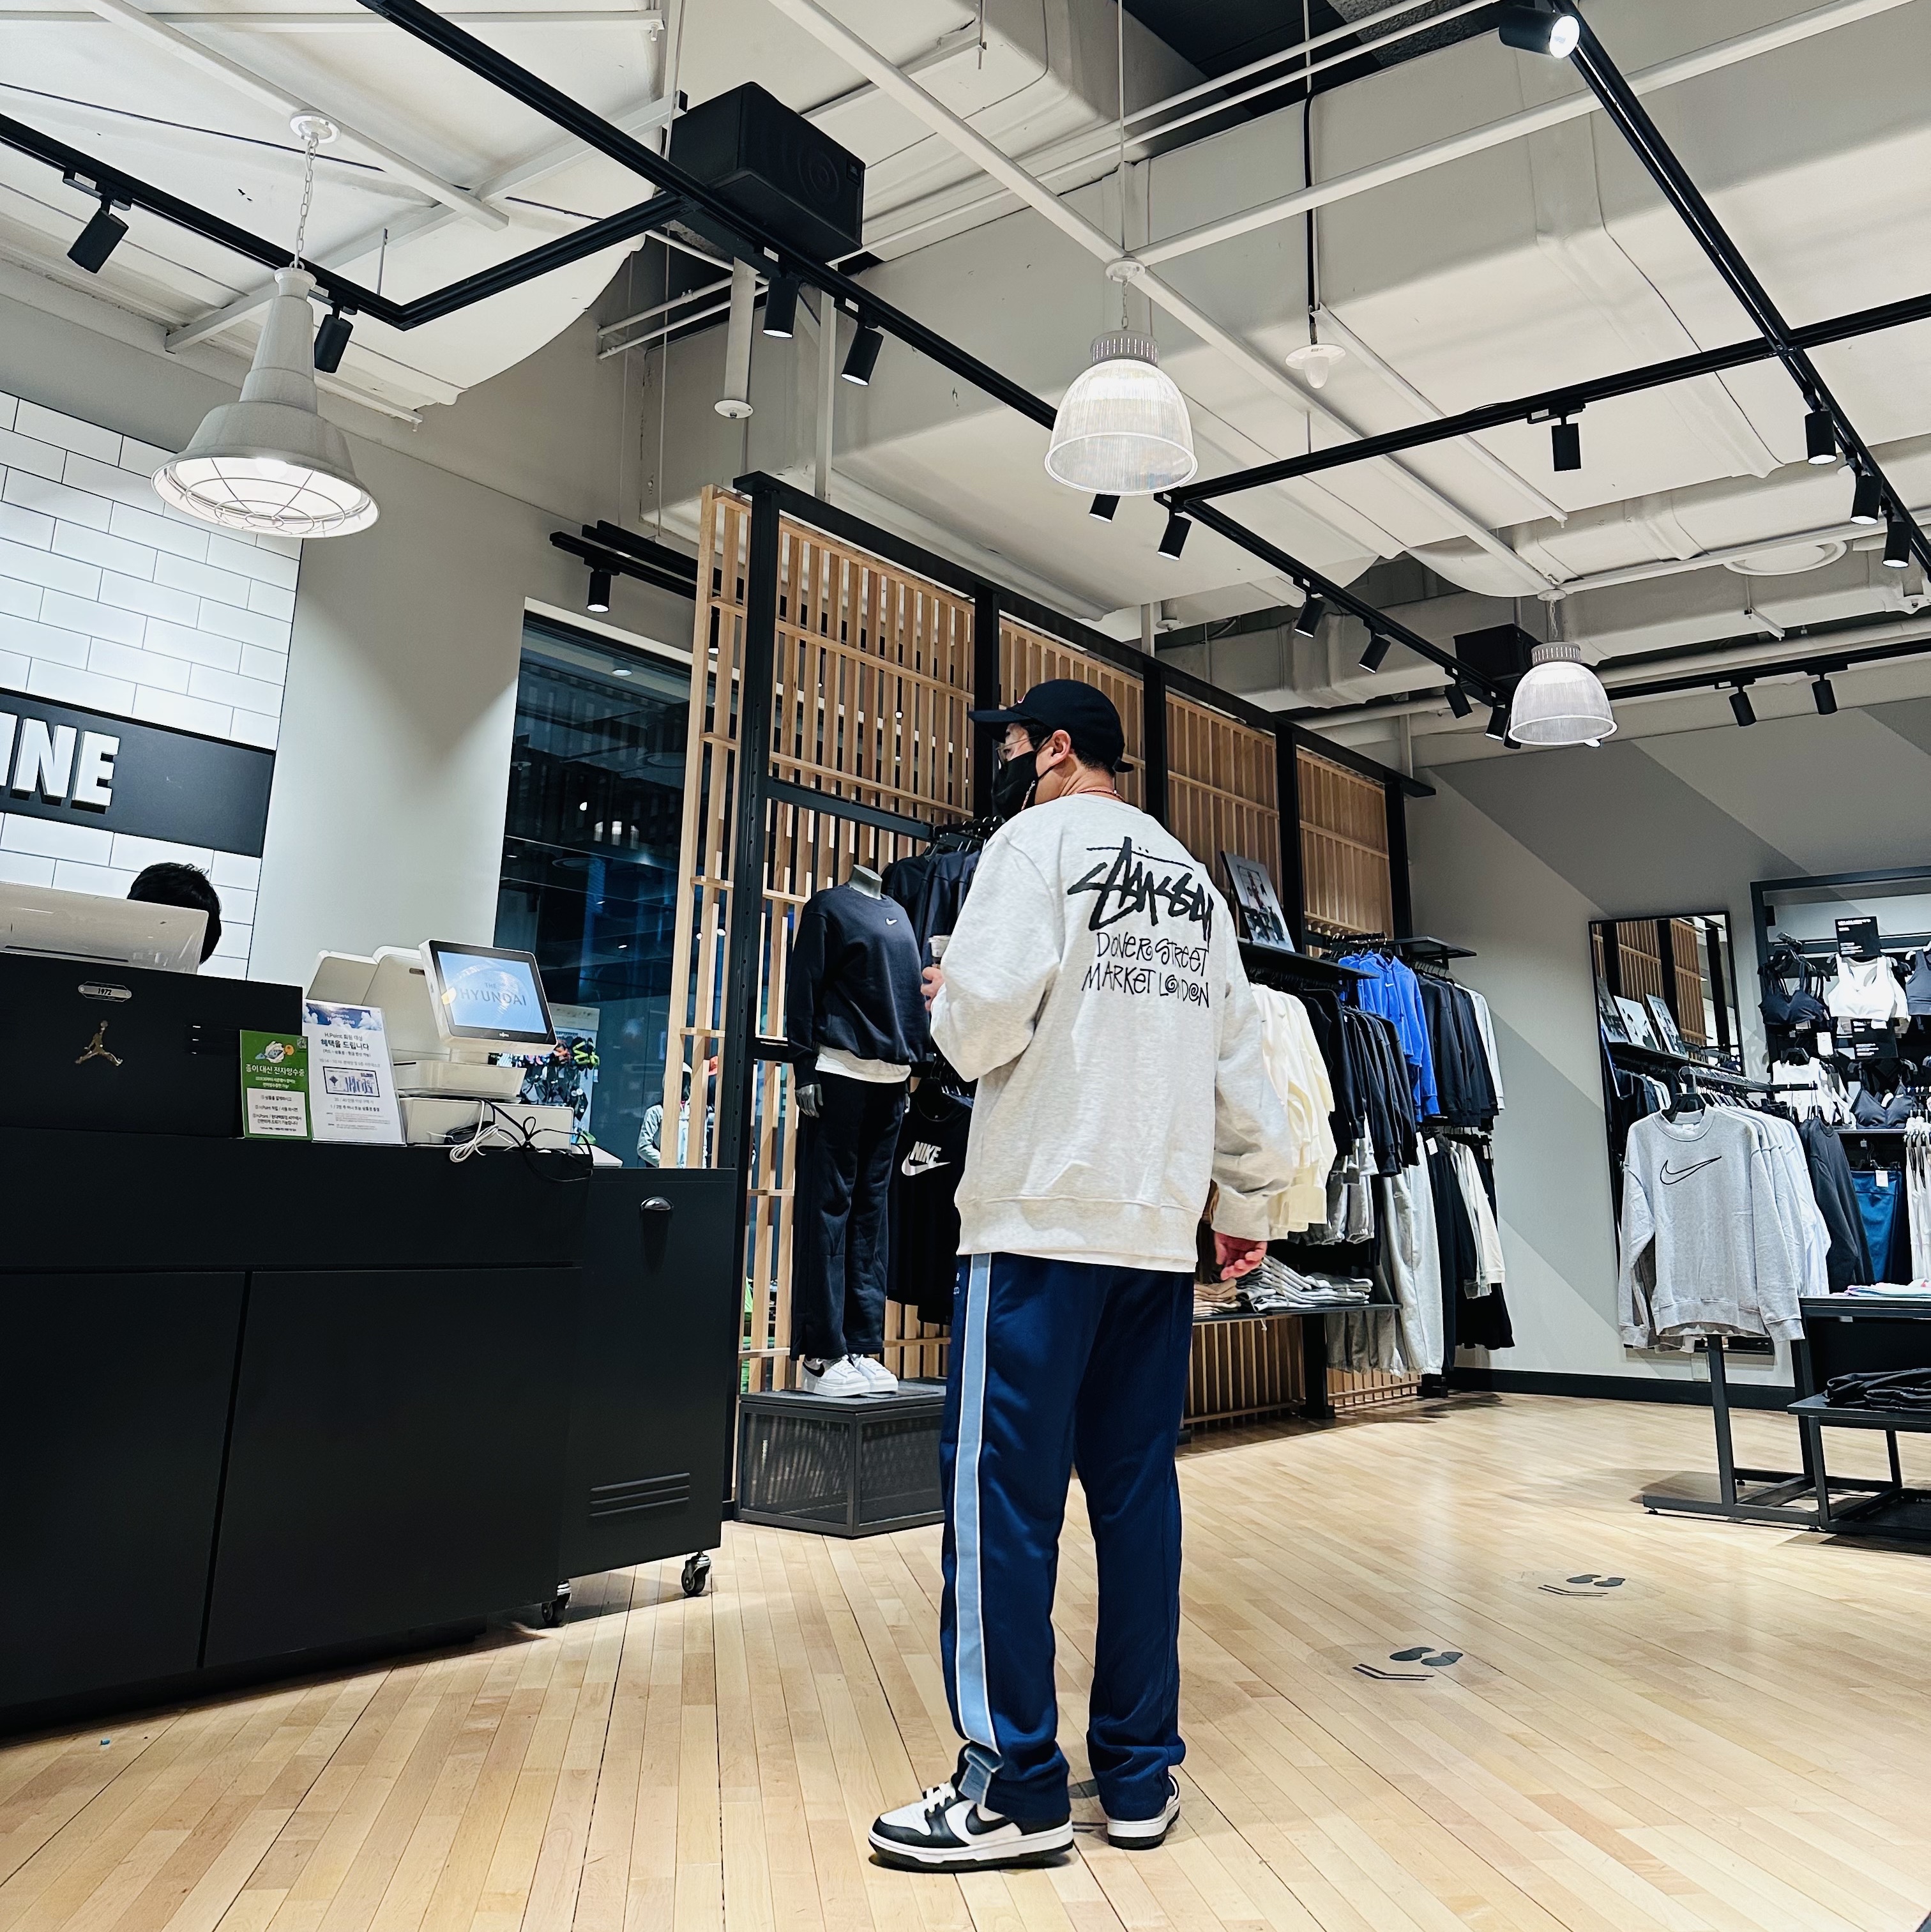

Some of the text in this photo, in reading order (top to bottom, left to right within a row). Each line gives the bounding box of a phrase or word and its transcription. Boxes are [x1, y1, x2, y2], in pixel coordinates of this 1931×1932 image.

[460, 988, 527, 1006] HYUNDAI
[321, 1038, 369, 1051] 혜택을 드립니다
[909, 1141, 942, 1164] NIKE
